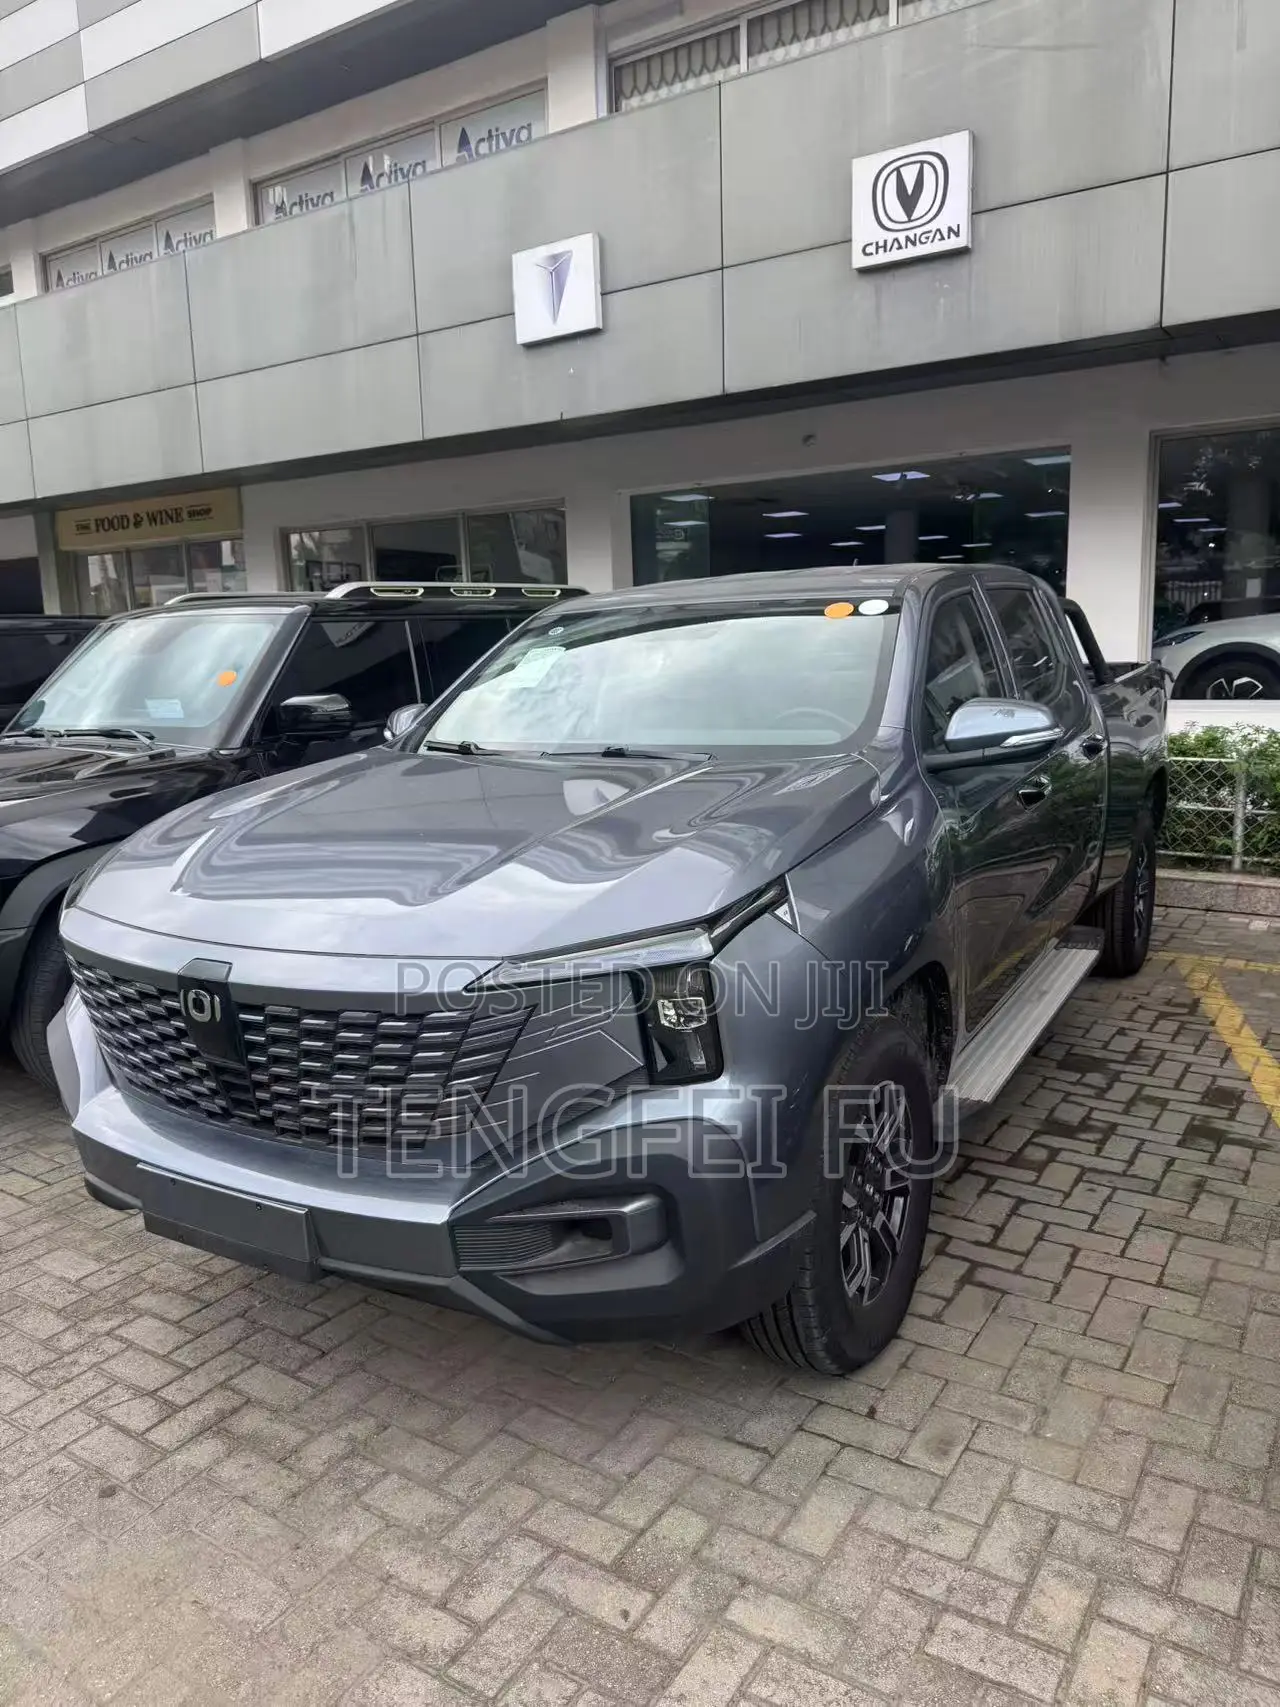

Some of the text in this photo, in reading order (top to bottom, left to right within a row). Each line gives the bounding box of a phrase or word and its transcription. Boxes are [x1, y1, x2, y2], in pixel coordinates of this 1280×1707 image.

[456, 122, 533, 161] Activa
[861, 223, 961, 257] CHANGAN
[94, 514, 131, 533] FOOD
[133, 511, 145, 530] &
[146, 507, 185, 527] WINE
[187, 507, 213, 519] SHOP
